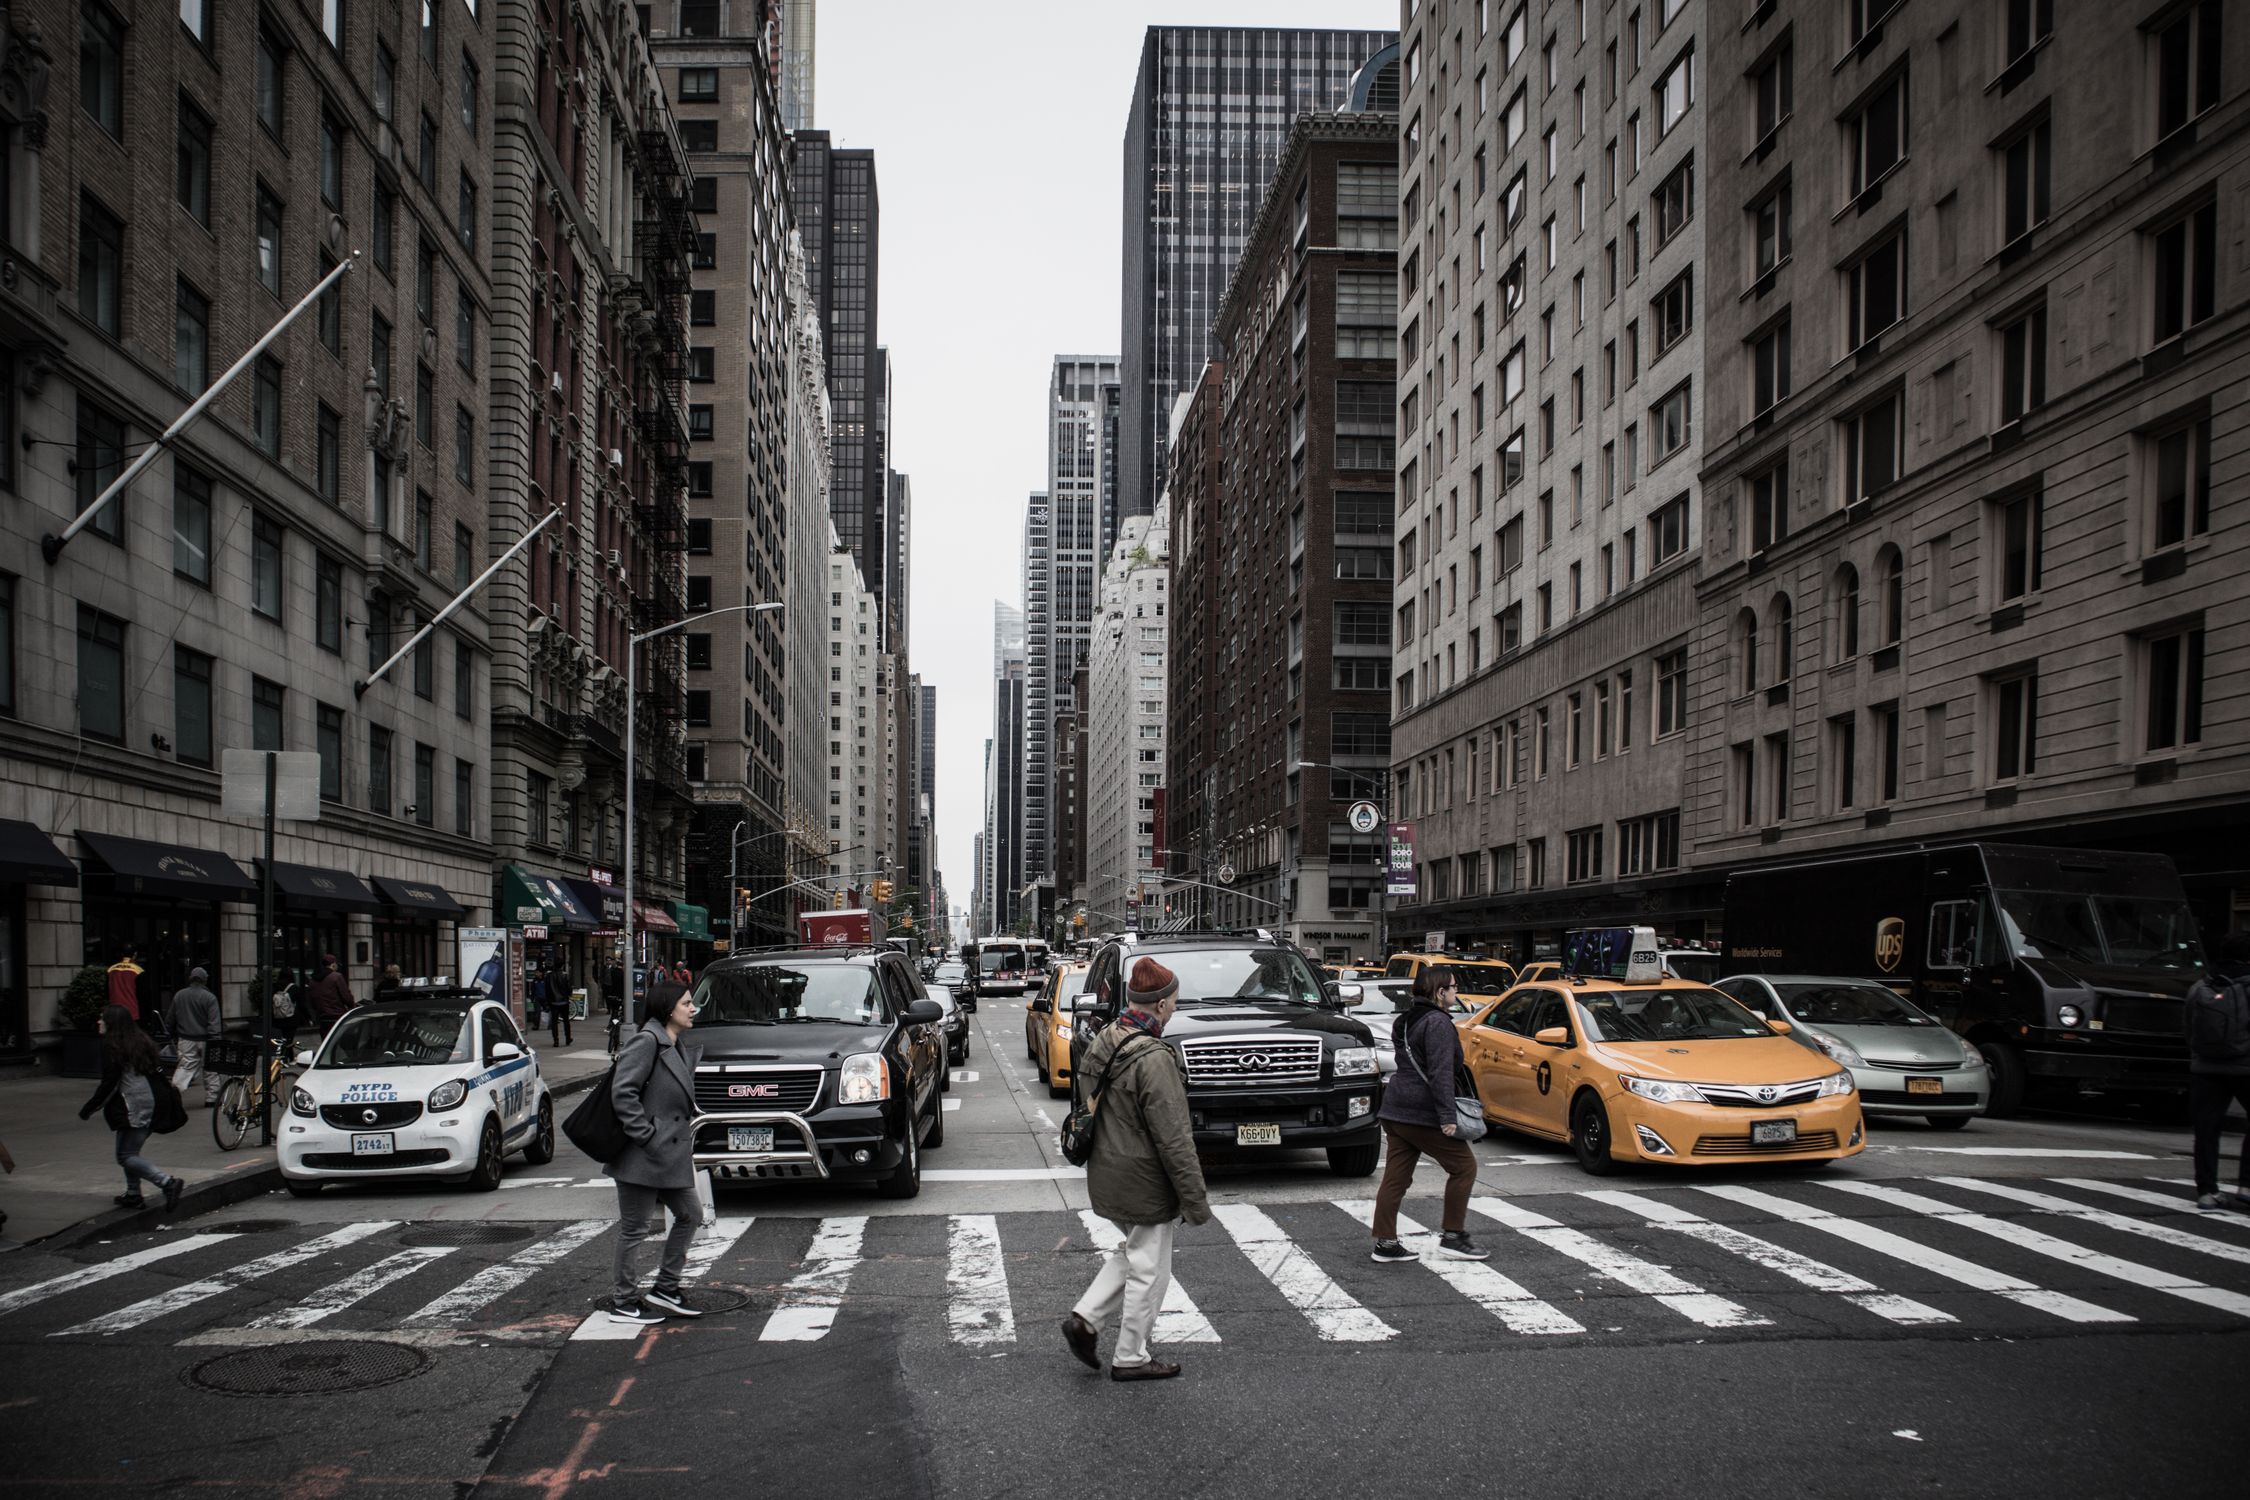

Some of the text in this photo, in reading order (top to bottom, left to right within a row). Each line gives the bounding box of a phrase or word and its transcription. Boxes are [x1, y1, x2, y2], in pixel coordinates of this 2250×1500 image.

[1391, 861, 1412, 869] TOUR
[526, 929, 545, 939] ATM
[1303, 932, 1370, 940] WINDSOR PHARMACY
[1731, 946, 1783, 958] Worldwide Services
[1878, 934, 1903, 964] ups
[1633, 953, 1656, 963] 6B25
[636, 973, 643, 983] P
[349, 1083, 393, 1092] NYPD
[728, 1084, 779, 1097] GMC
[340, 1092, 398, 1103] POLICE
[357, 1139, 382, 1151] 2742
[732, 1134, 771, 1146] T507383C
